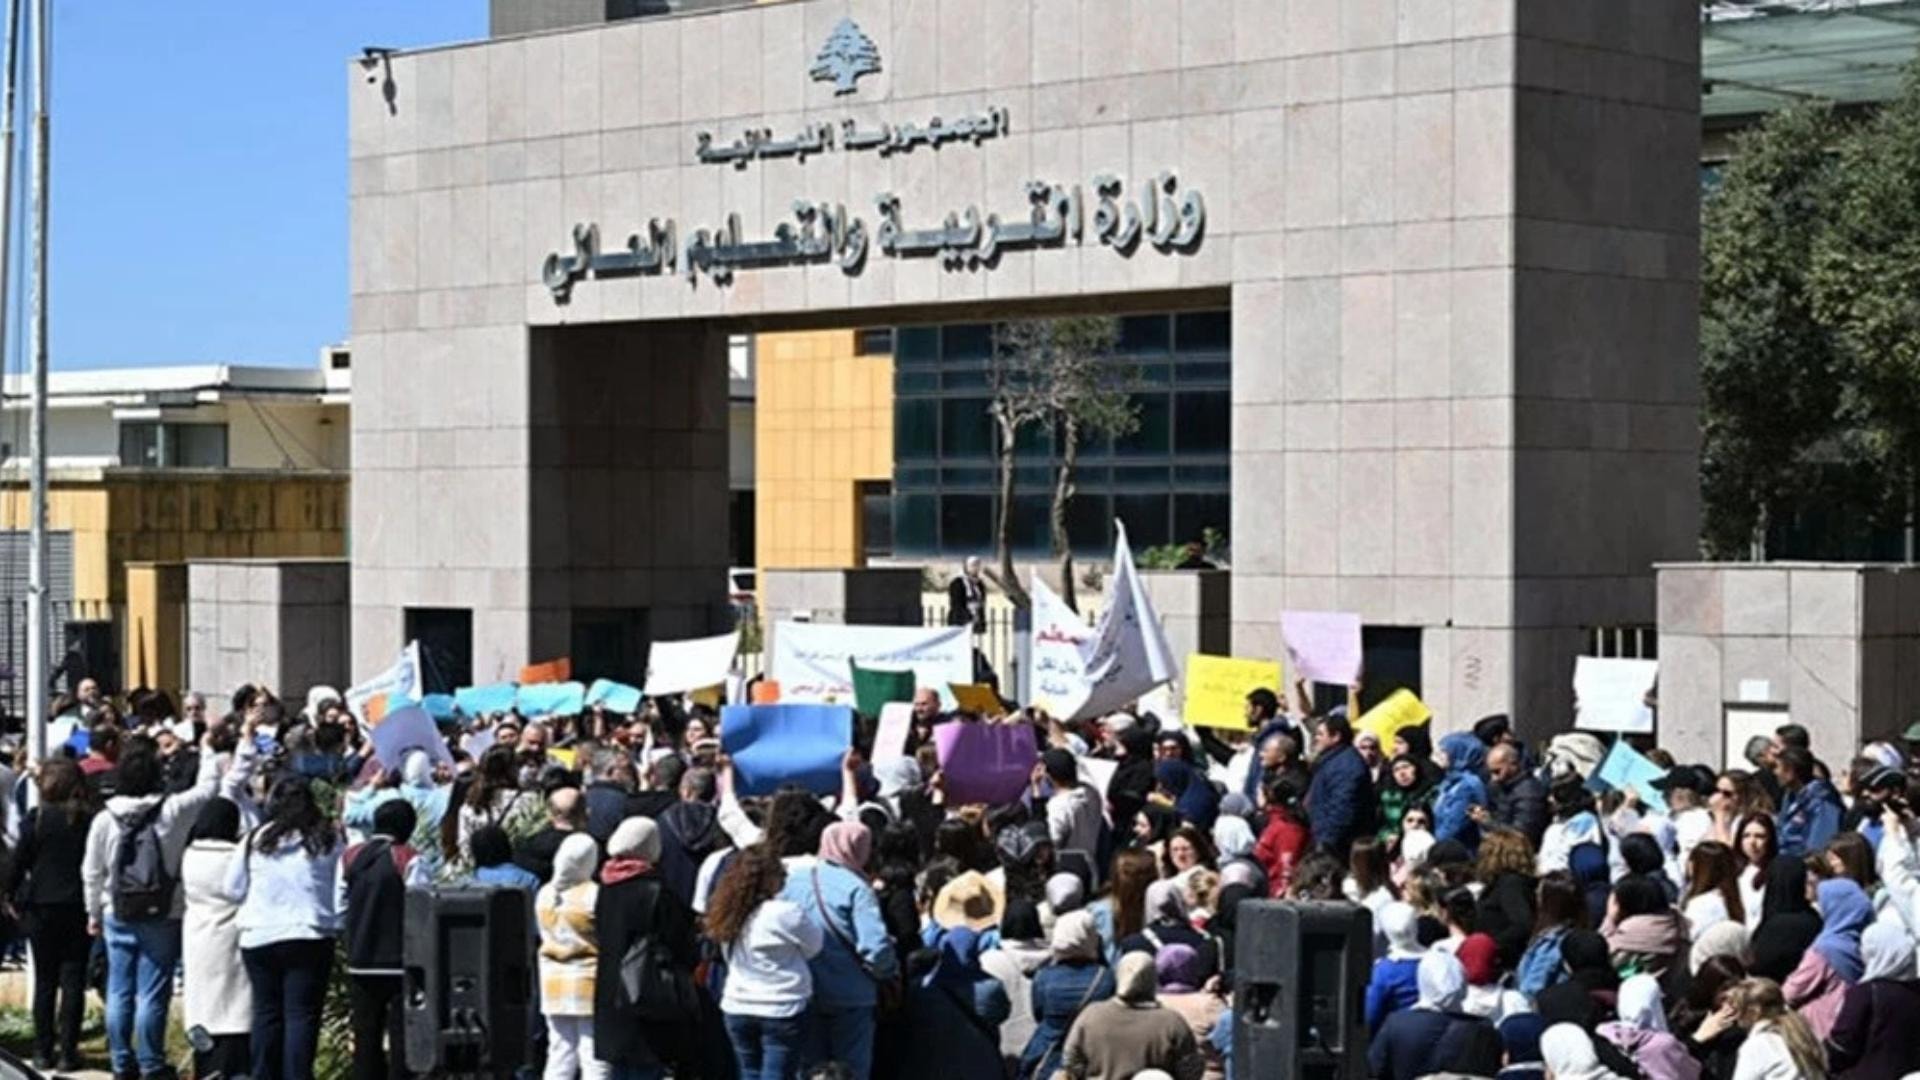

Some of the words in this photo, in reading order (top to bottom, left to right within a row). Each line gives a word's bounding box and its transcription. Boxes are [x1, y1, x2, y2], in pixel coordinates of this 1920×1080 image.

[696, 121, 835, 171] اللبنانية
[842, 106, 1009, 158] الجمهورية
[686, 199, 869, 292] والتعليم
[877, 181, 1083, 273] التربية
[1094, 170, 1205, 258] وزارة
[542, 217, 678, 306] العالي
